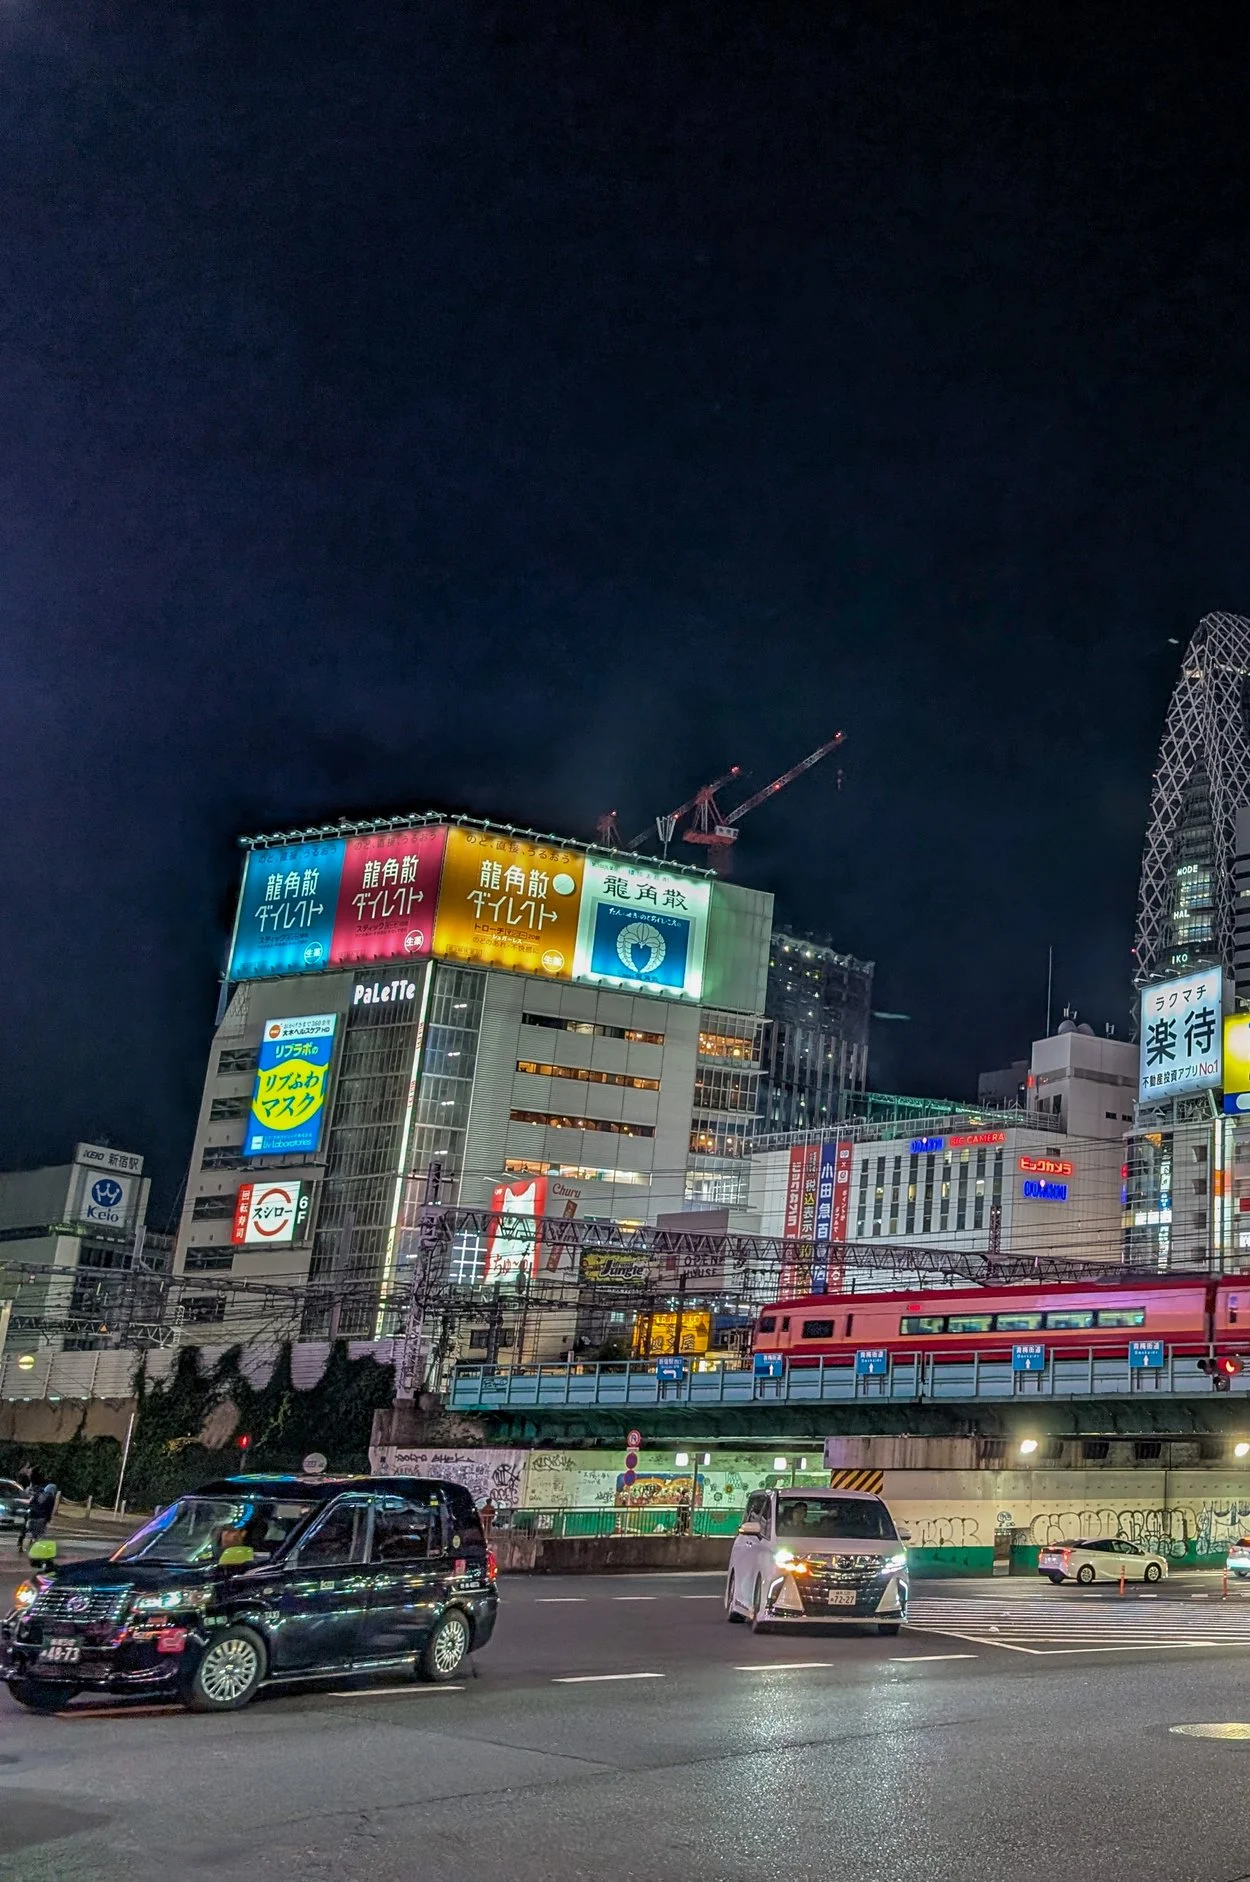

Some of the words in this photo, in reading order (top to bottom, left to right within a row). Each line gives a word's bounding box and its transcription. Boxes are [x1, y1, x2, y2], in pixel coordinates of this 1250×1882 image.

[467, 833, 570, 864] のど、直接、うるおう
[265, 867, 320, 901] 龍角散
[362, 855, 419, 889] 龍角散
[480, 860, 549, 899] 龍角散
[352, 887, 424, 920] ダイレクト
[603, 875, 688, 911] 龍角散
[254, 900, 324, 932] ダイレクト
[467, 889, 558, 931] ダイレクト
[1155, 984, 1207, 1011] ラクマチ
[1146, 1006, 1216, 1067] 楽待
[261, 1093, 315, 1118] マスク
[967, 1132, 1006, 1145] CAMERA
[108, 1153, 139, 1170] 新宿駅
[1020, 1157, 1073, 1175] ビックカメラ
[552, 1183, 581, 1198] Churu
[87, 1205, 119, 1222] Keio
[252, 1206, 293, 1219] スシロー
